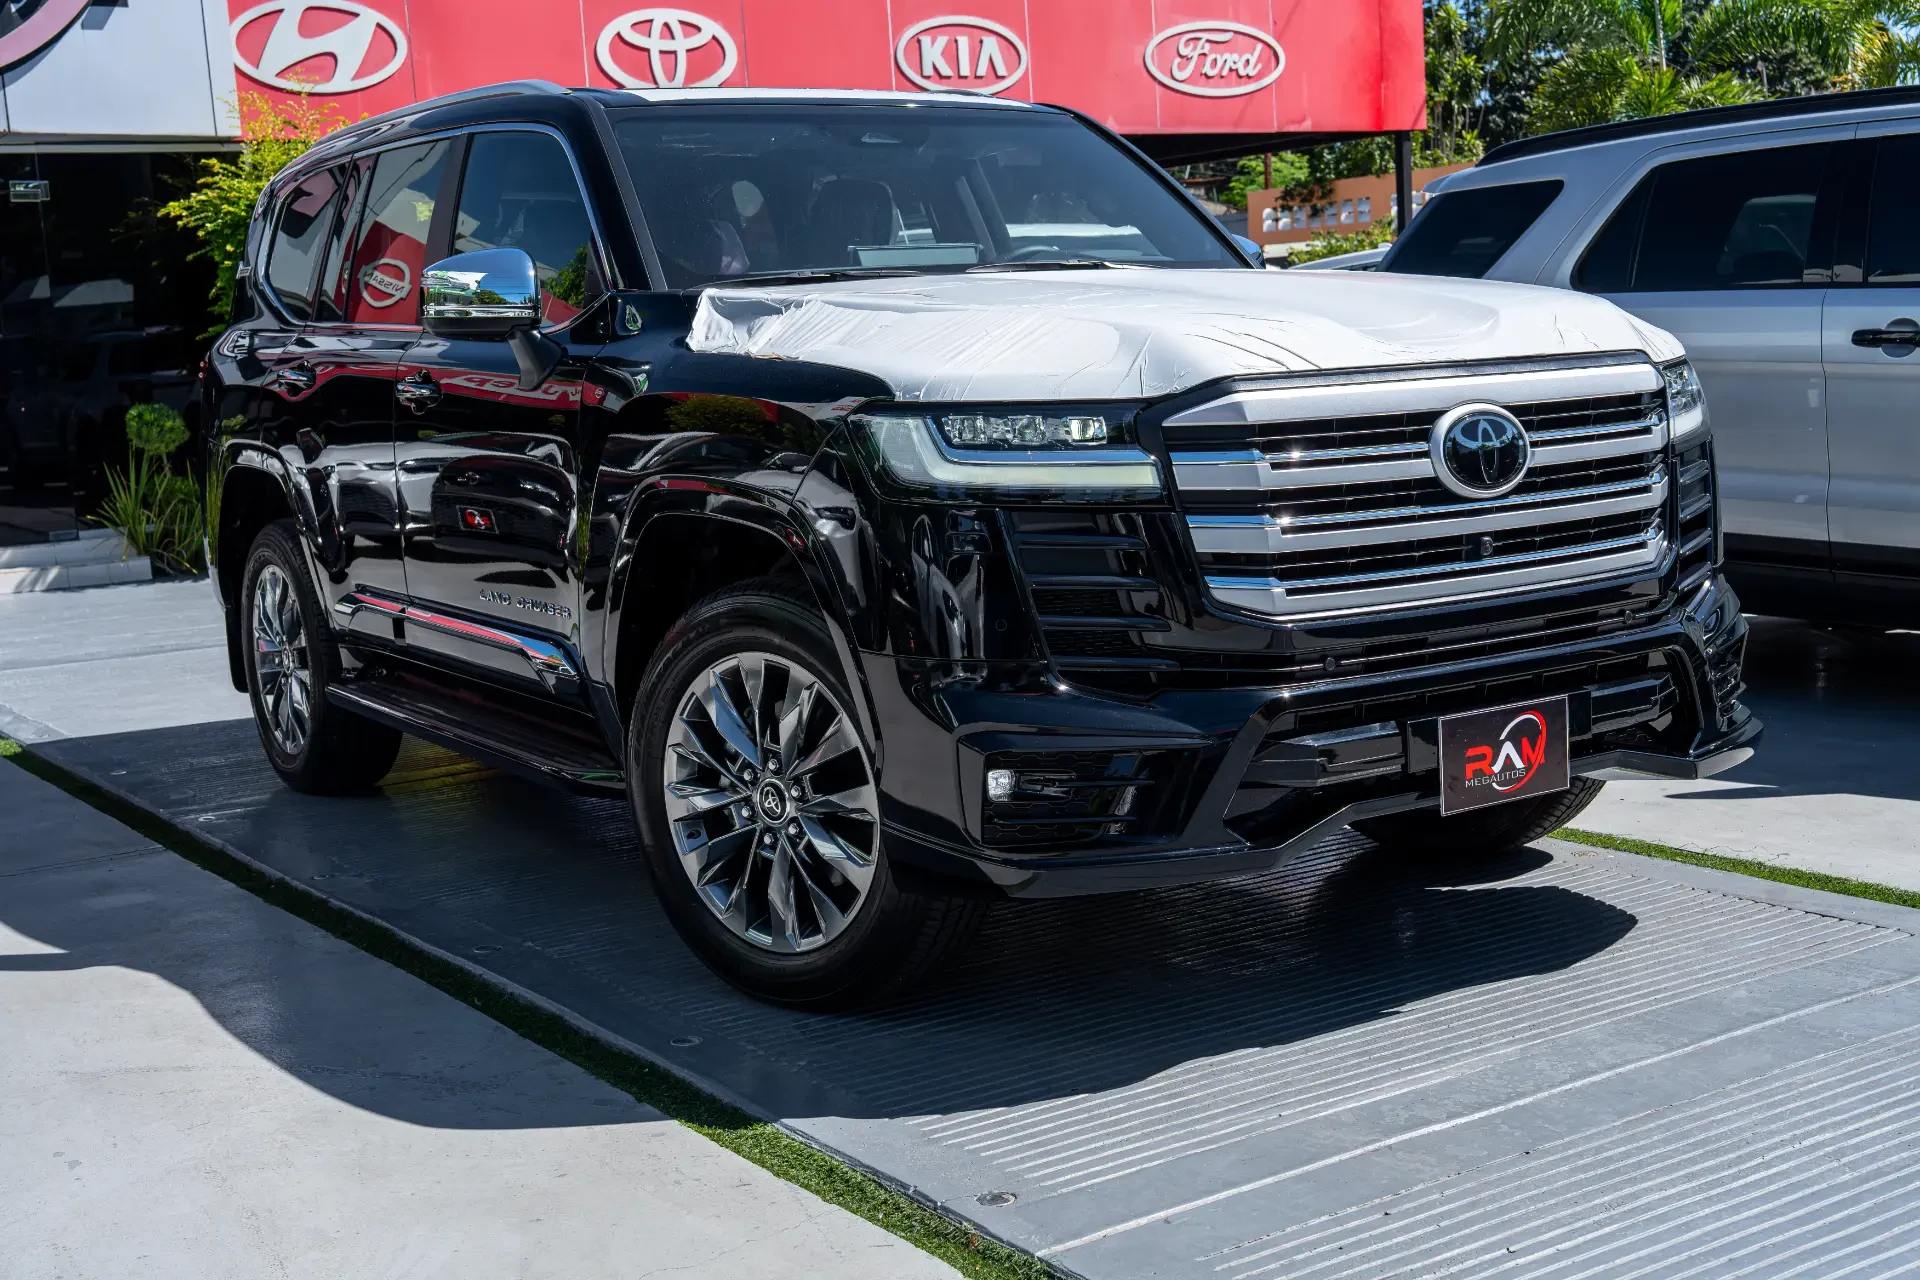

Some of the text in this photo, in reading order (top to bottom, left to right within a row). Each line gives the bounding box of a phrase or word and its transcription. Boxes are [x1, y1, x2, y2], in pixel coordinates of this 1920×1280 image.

[918, 35, 1008, 78] KIA
[1171, 31, 1263, 81] Ford
[479, 588, 572, 620] LAND CRUISER
[1465, 735, 1545, 780] RAM
[1465, 768, 1527, 788] MEGAUTOS
